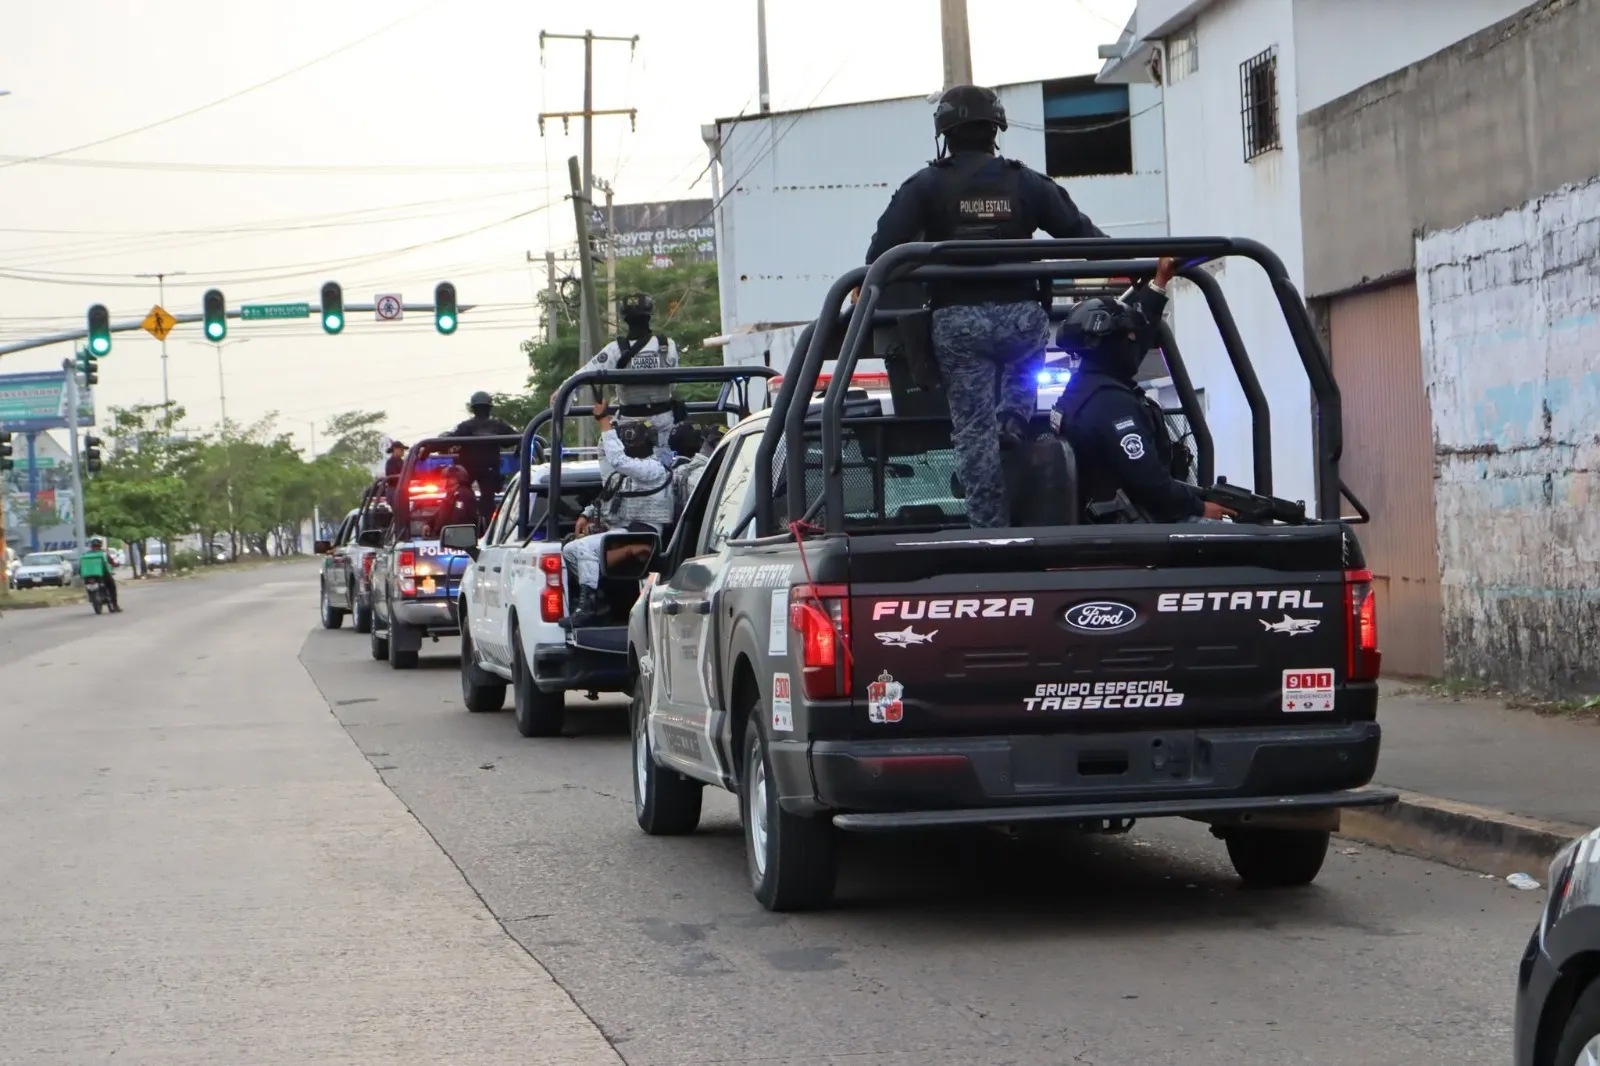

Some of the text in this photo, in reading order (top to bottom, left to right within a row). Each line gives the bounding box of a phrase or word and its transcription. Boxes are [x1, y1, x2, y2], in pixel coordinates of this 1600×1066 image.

[985, 200, 1011, 212] ESTATAL
[688, 226, 715, 242] que
[872, 597, 1035, 620] FUERZA
[1157, 590, 1324, 612] ESTATAL
[1077, 605, 1123, 626] Ford
[1035, 680, 1174, 697] GRUPO ESPECIAL
[1289, 675, 1327, 688] 911
[1023, 693, 1185, 711] TABSCOOB
